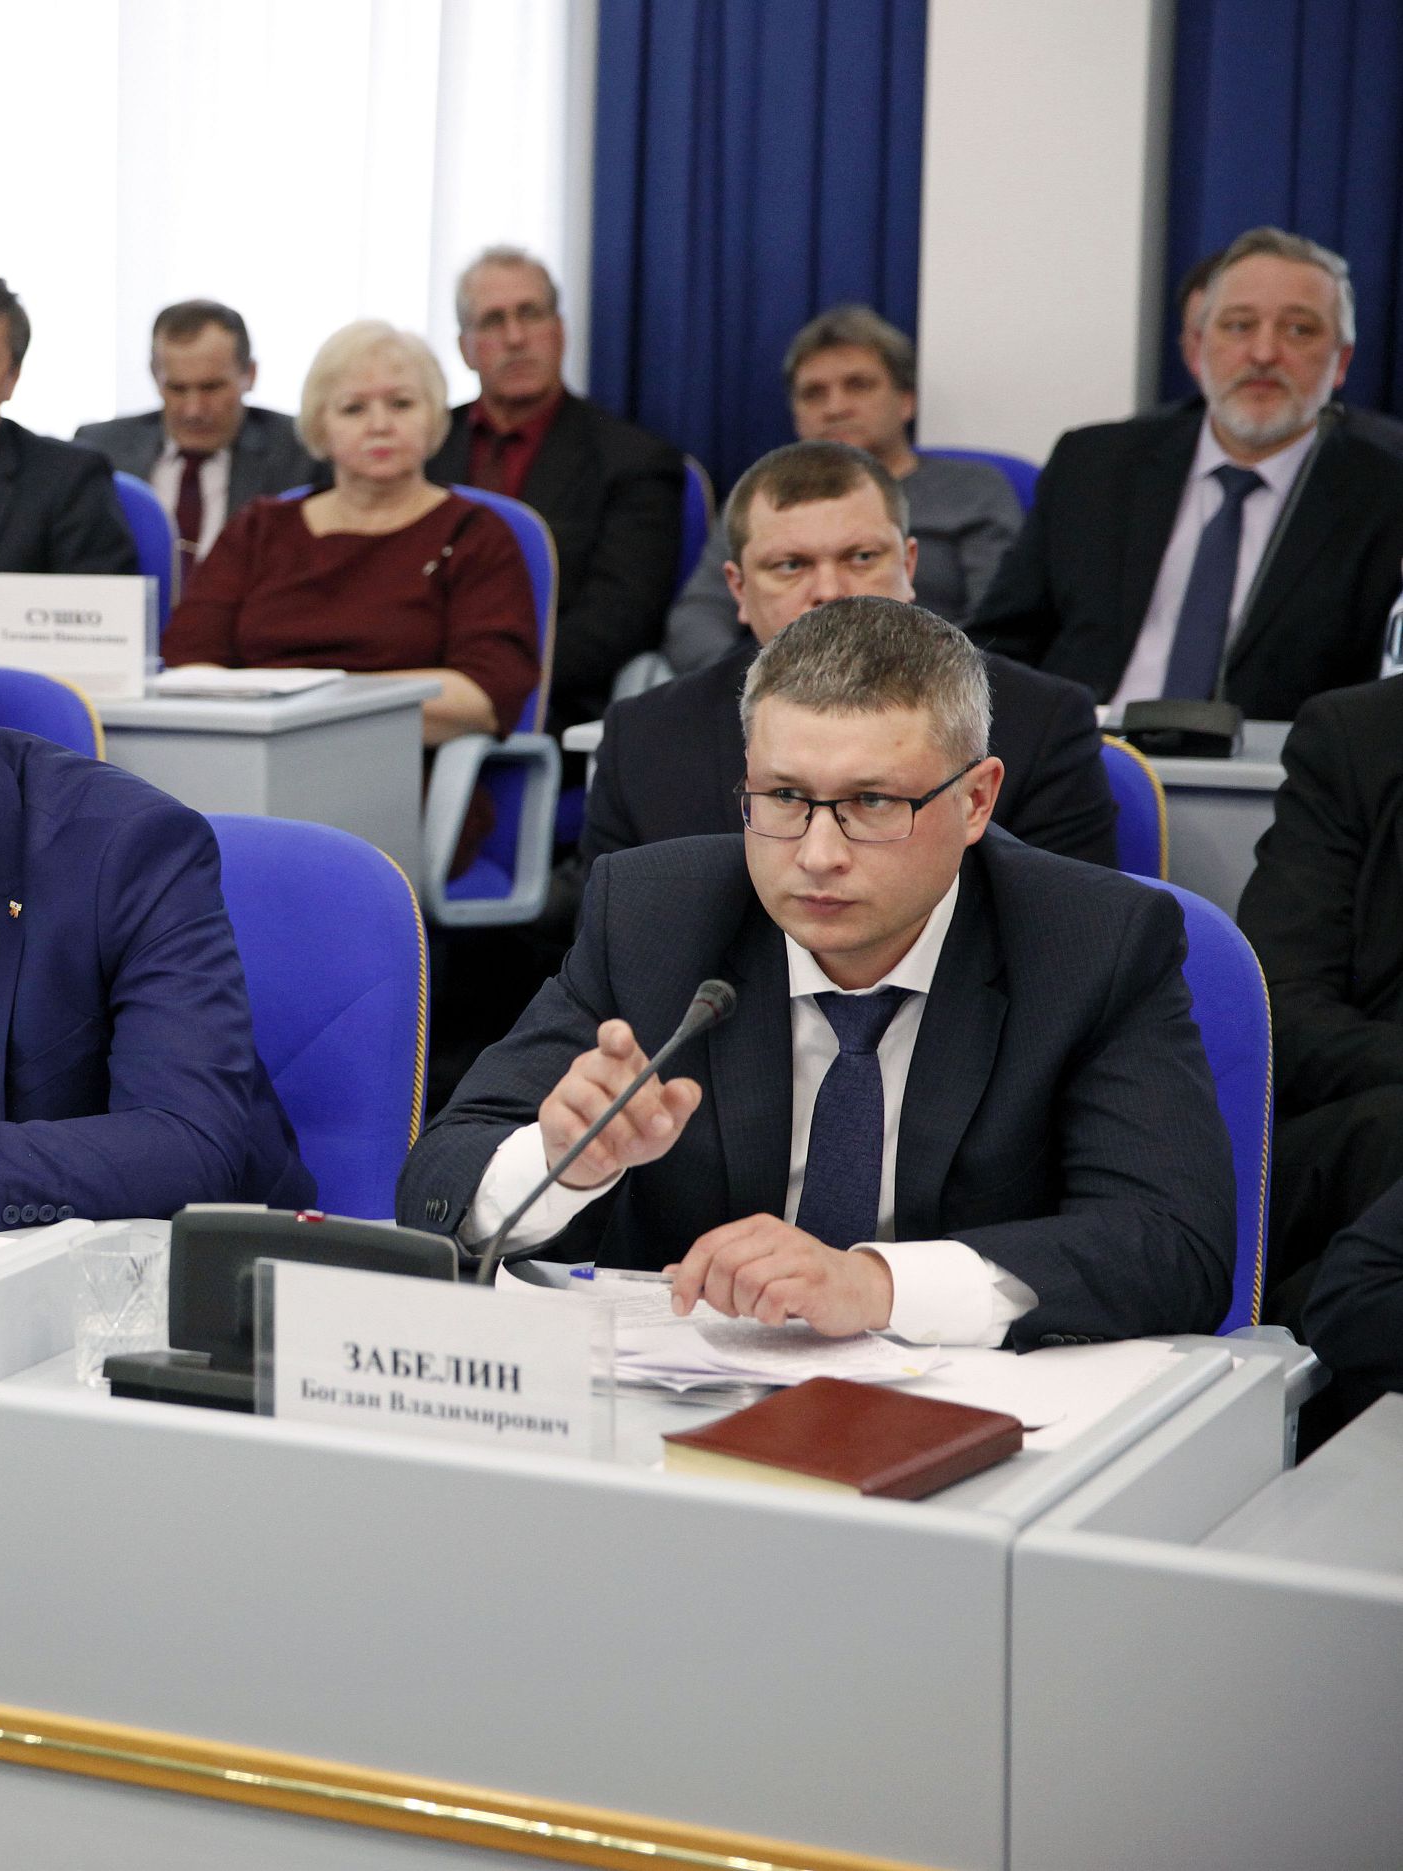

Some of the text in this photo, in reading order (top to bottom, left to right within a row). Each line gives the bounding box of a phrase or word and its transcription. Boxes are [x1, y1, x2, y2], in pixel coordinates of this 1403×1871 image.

[343, 1341, 521, 1393] ЗАБЕЛИН
[300, 1377, 569, 1435] Богдан Владимирович
